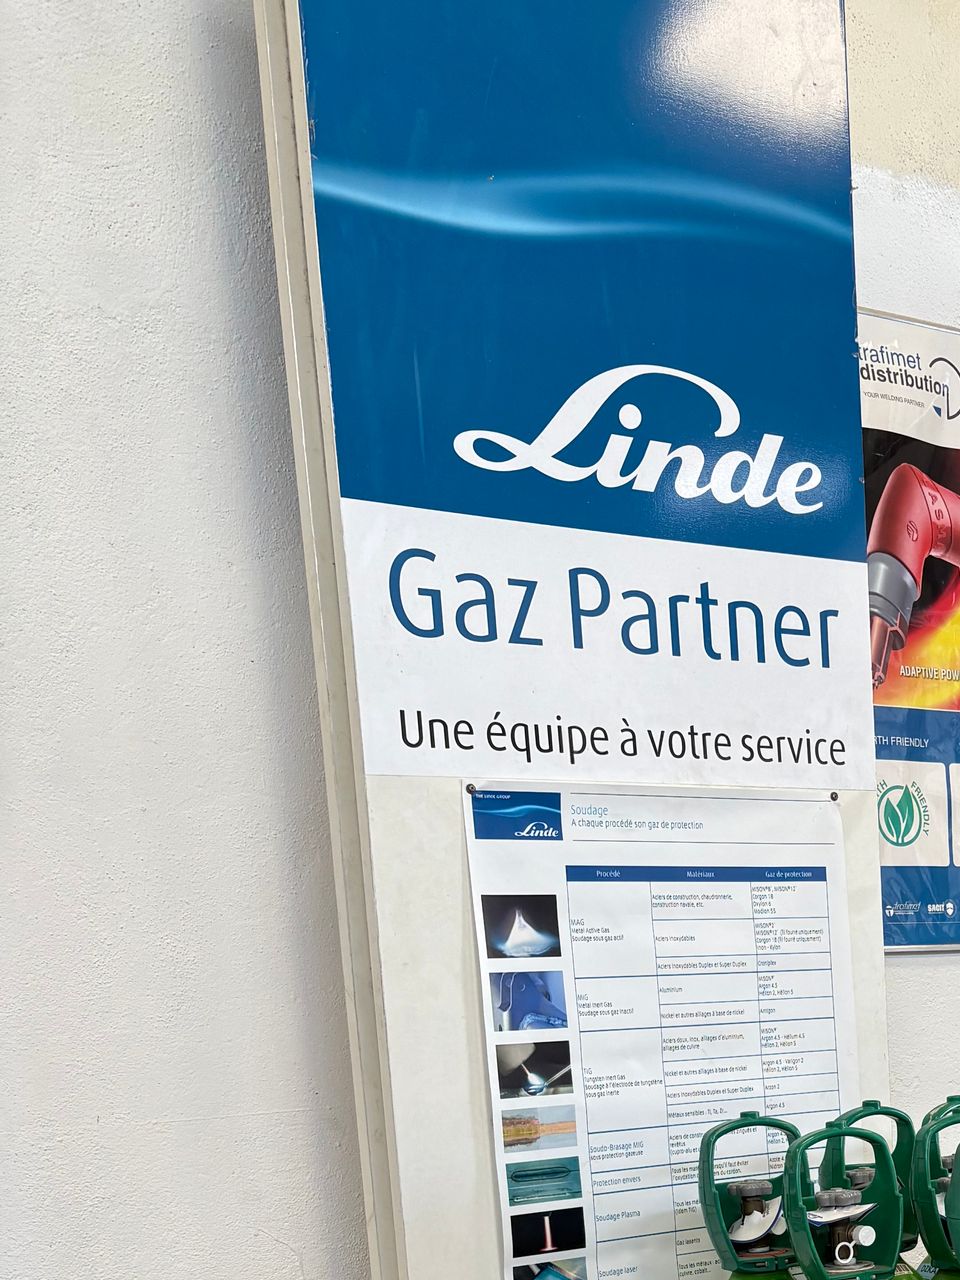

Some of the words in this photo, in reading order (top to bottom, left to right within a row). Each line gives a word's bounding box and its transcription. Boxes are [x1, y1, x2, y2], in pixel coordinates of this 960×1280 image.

[858, 345, 922, 371] trafimet
[860, 364, 949, 398] distribution
[863, 391, 880, 399] YOUR
[880, 394, 904, 404] WELDING
[904, 398, 925, 409] PARTNER
[453, 364, 824, 515] Linde
[388, 547, 544, 647] Gaz
[568, 566, 839, 669] Partner
[899, 665, 939, 680] ADAPTIVE
[399, 709, 474, 750] Une
[486, 711, 609, 765] équipe
[619, 718, 638, 757] à
[647, 724, 732, 762] votre
[740, 729, 846, 766] service
[890, 736, 930, 748] FRIENDLY
[570, 804, 608, 819] Soudage
[911, 781, 930, 837] FRIENDLY
[515, 821, 560, 839] Linde
[571, 819, 578, 827] A
[578, 818, 604, 831] chaque
[604, 818, 633, 831] procédé
[634, 821, 647, 829] son
[648, 822, 659, 832] gaz
[660, 820, 669, 829] de
[670, 820, 704, 831] protection
[596, 869, 621, 878] Procédé
[686, 870, 716, 878] Matériaux
[765, 870, 775, 878] Gaz
[776, 870, 784, 878] de
[784, 870, 812, 880] protection
[672, 893, 700, 902] construction,
[571, 918, 584, 926] MAG
[572, 934, 592, 943] Soudage
[592, 934, 604, 942] sous
[603, 934, 613, 943] gaz
[698, 961, 714, 970] Duplex
[719, 961, 732, 970] Super
[731, 960, 747, 969] Duplex
[579, 1010, 600, 1018] Soudage
[599, 1009, 611, 1017] sous
[732, 1008, 745, 1016] nickel
[718, 1067, 729, 1075] base
[729, 1066, 735, 1074] de
[735, 1065, 748, 1074] nickel
[585, 1082, 605, 1092] Soudage
[634, 1080, 640, 1088] de
[706, 1087, 722, 1097] Duplex
[727, 1086, 739, 1095] Super
[739, 1086, 754, 1095] Duplex
[585, 1091, 597, 1099] sous
[668, 1111, 682, 1119] Métaux
[589, 1143, 632, 1154] Soudo-Brasage
[632, 1141, 644, 1150] MIG
[590, 1154, 601, 1162] sous
[601, 1151, 627, 1161] protection
[626, 1150, 644, 1159] gazeuse
[593, 1176, 621, 1188] Protection
[621, 1175, 642, 1184] envers
[595, 1212, 621, 1223] Soudage
[621, 1209, 641, 1219] Plasma
[599, 1267, 624, 1279] Soudage
[624, 1264, 639, 1274] laser
